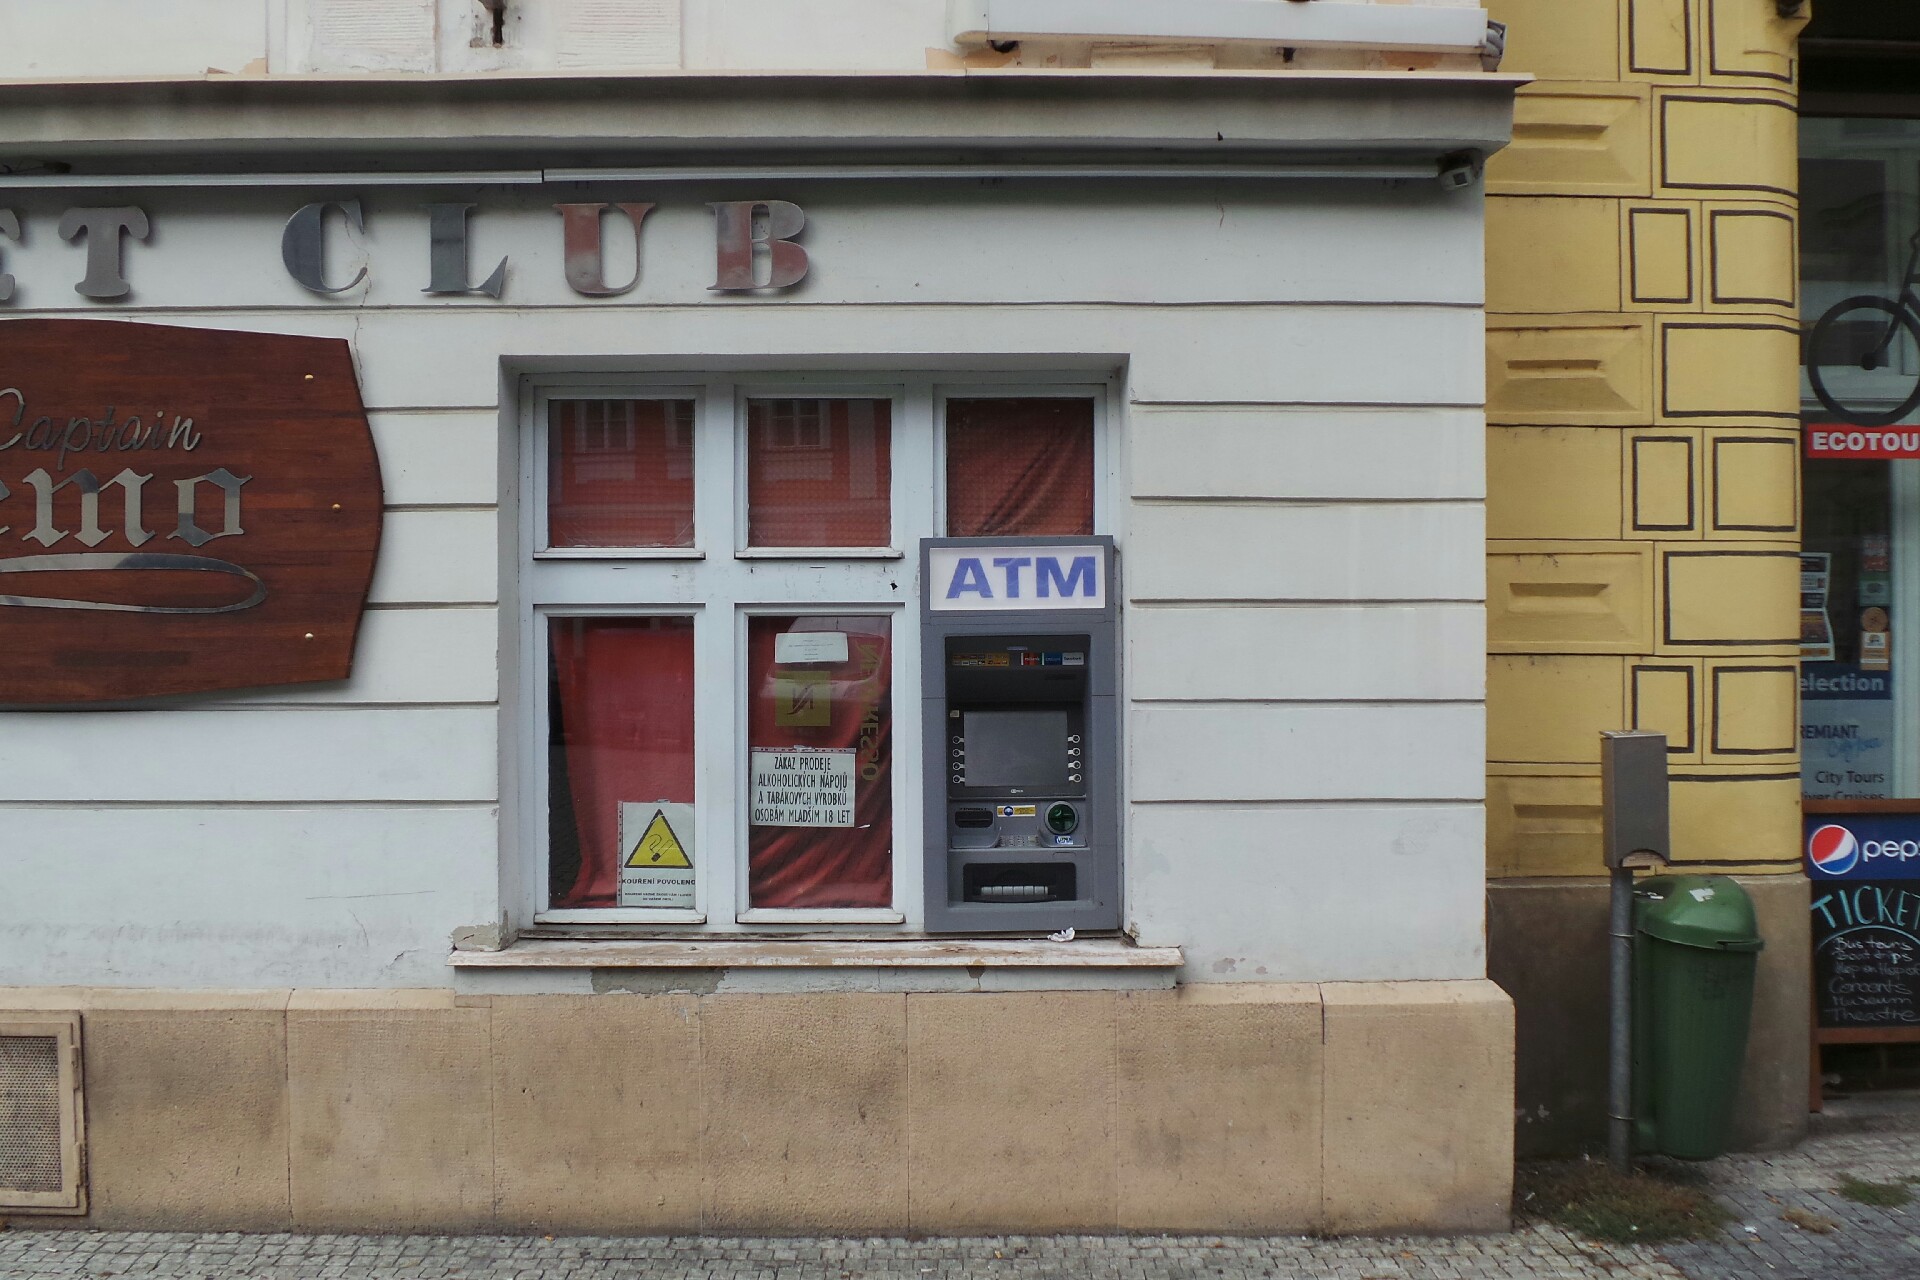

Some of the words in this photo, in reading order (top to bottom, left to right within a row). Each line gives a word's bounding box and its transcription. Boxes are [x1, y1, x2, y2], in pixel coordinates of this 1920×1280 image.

[281, 199, 809, 298] CLUB
[0, 387, 201, 471] Captain
[1812, 432, 1919, 451] ECOTOU
[946, 556, 1096, 599] ATM
[774, 754, 796, 770] ZÁKAZ
[799, 757, 831, 774] PRODEJE
[758, 771, 816, 788] ALKOHOLICKÝCH
[820, 772, 848, 791] NÁPOJŮ
[1815, 770, 1842, 788] City
[1846, 770, 1885, 783] Tours
[758, 790, 764, 804] A
[767, 788, 811, 805] TABÁKOVÝCH
[814, 789, 847, 806] VÝROBKŮ
[755, 805, 784, 822] OSOBÁM
[789, 806, 820, 823] MLADŠÍM
[825, 810, 834, 824] 18
[837, 810, 851, 824] LET
[1809, 885, 1920, 931] TICKET
[1833, 937, 1863, 949] Bus
[1866, 935, 1914, 951] tours
